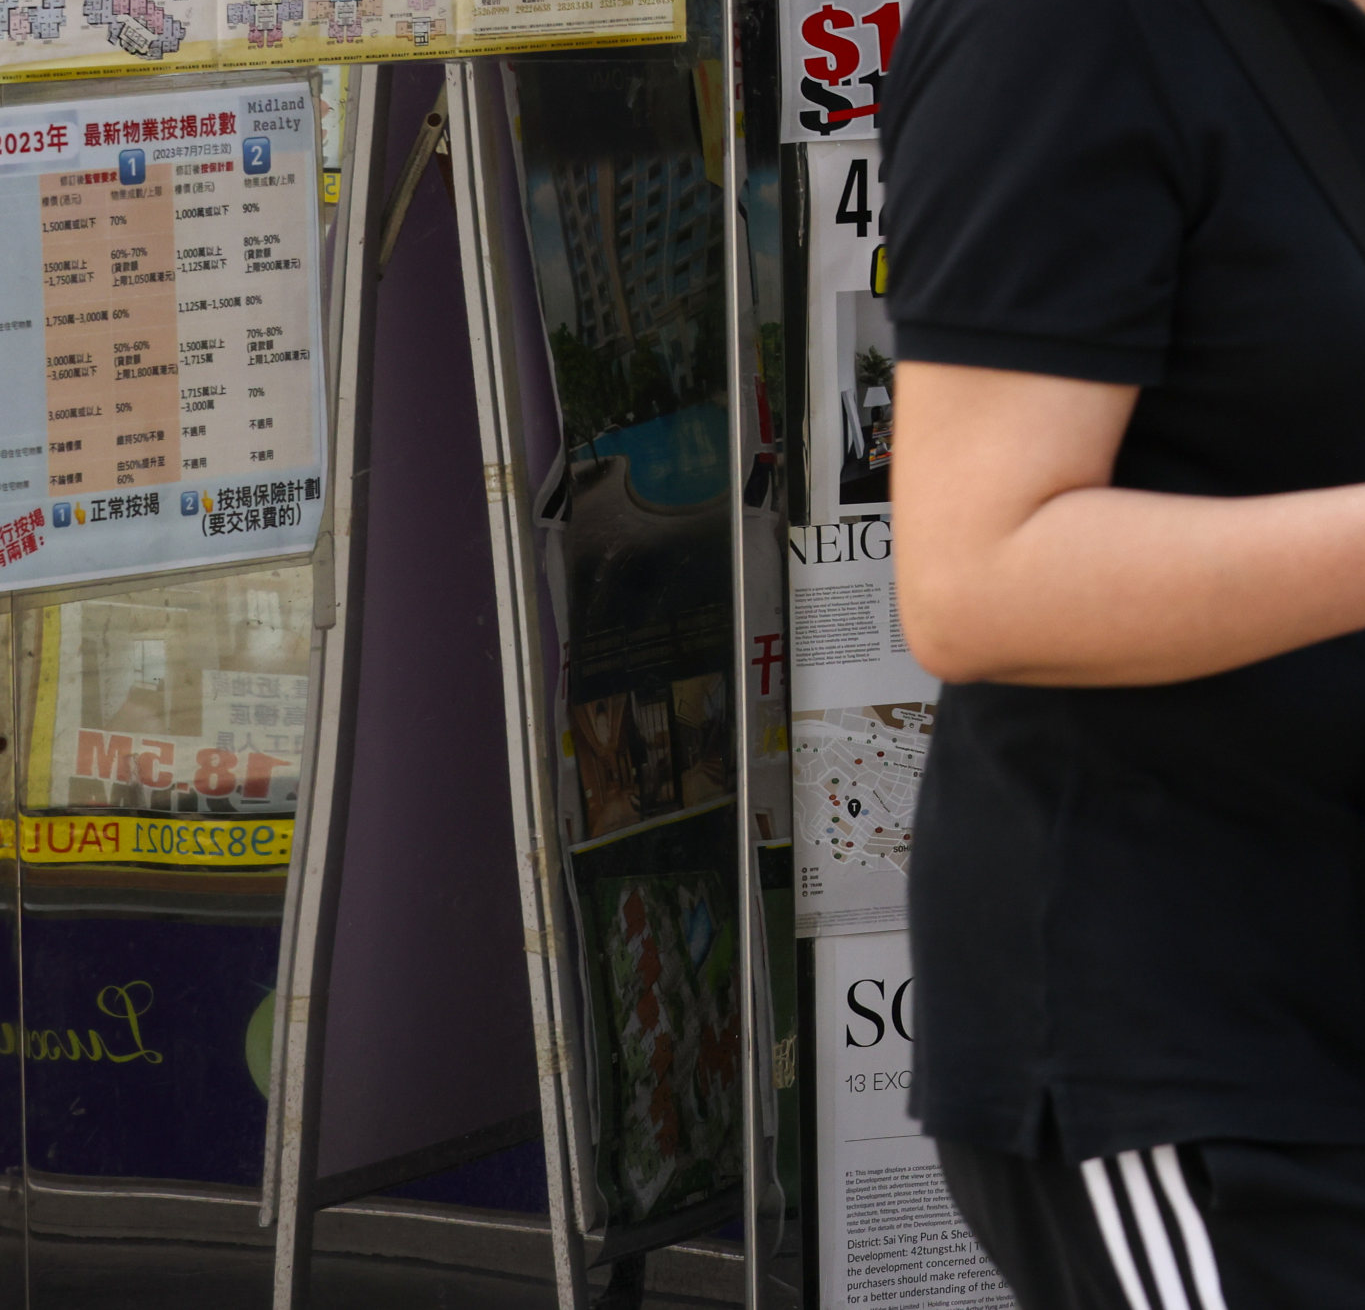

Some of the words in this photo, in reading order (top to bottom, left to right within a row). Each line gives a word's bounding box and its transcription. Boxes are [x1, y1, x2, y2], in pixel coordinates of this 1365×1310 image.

[248, 97, 305, 114] Midland
[84, 112, 237, 147] 最新物業按揭成數
[253, 117, 301, 134] Realty
[242, 203, 260, 214] 90%
[110, 216, 127, 226] 70%
[245, 296, 262, 307] 80%
[112, 309, 129, 320] 60%
[90, 492, 160, 523] 正常按揭
[217, 477, 321, 511] 按揭保險計劃
[201, 502, 302, 536] (要交保費的)
[845, 1071, 866, 1094] 13
[846, 1236, 882, 1250] District:
[882, 1233, 897, 1245] Sai
[896, 1232, 919, 1245] Ying
[919, 1230, 939, 1242] Pun
[846, 1246, 909, 1264] Development:
[909, 1242, 967, 1257] 42tungst.hk
[864, 1260, 924, 1276] development
[925, 1254, 977, 1269] concerned
[846, 1276, 897, 1292] purchasers
[896, 1271, 928, 1285] should
[929, 1269, 956, 1282] make
[869, 1289, 898, 1303] better
[898, 1283, 967, 1300] understanding
